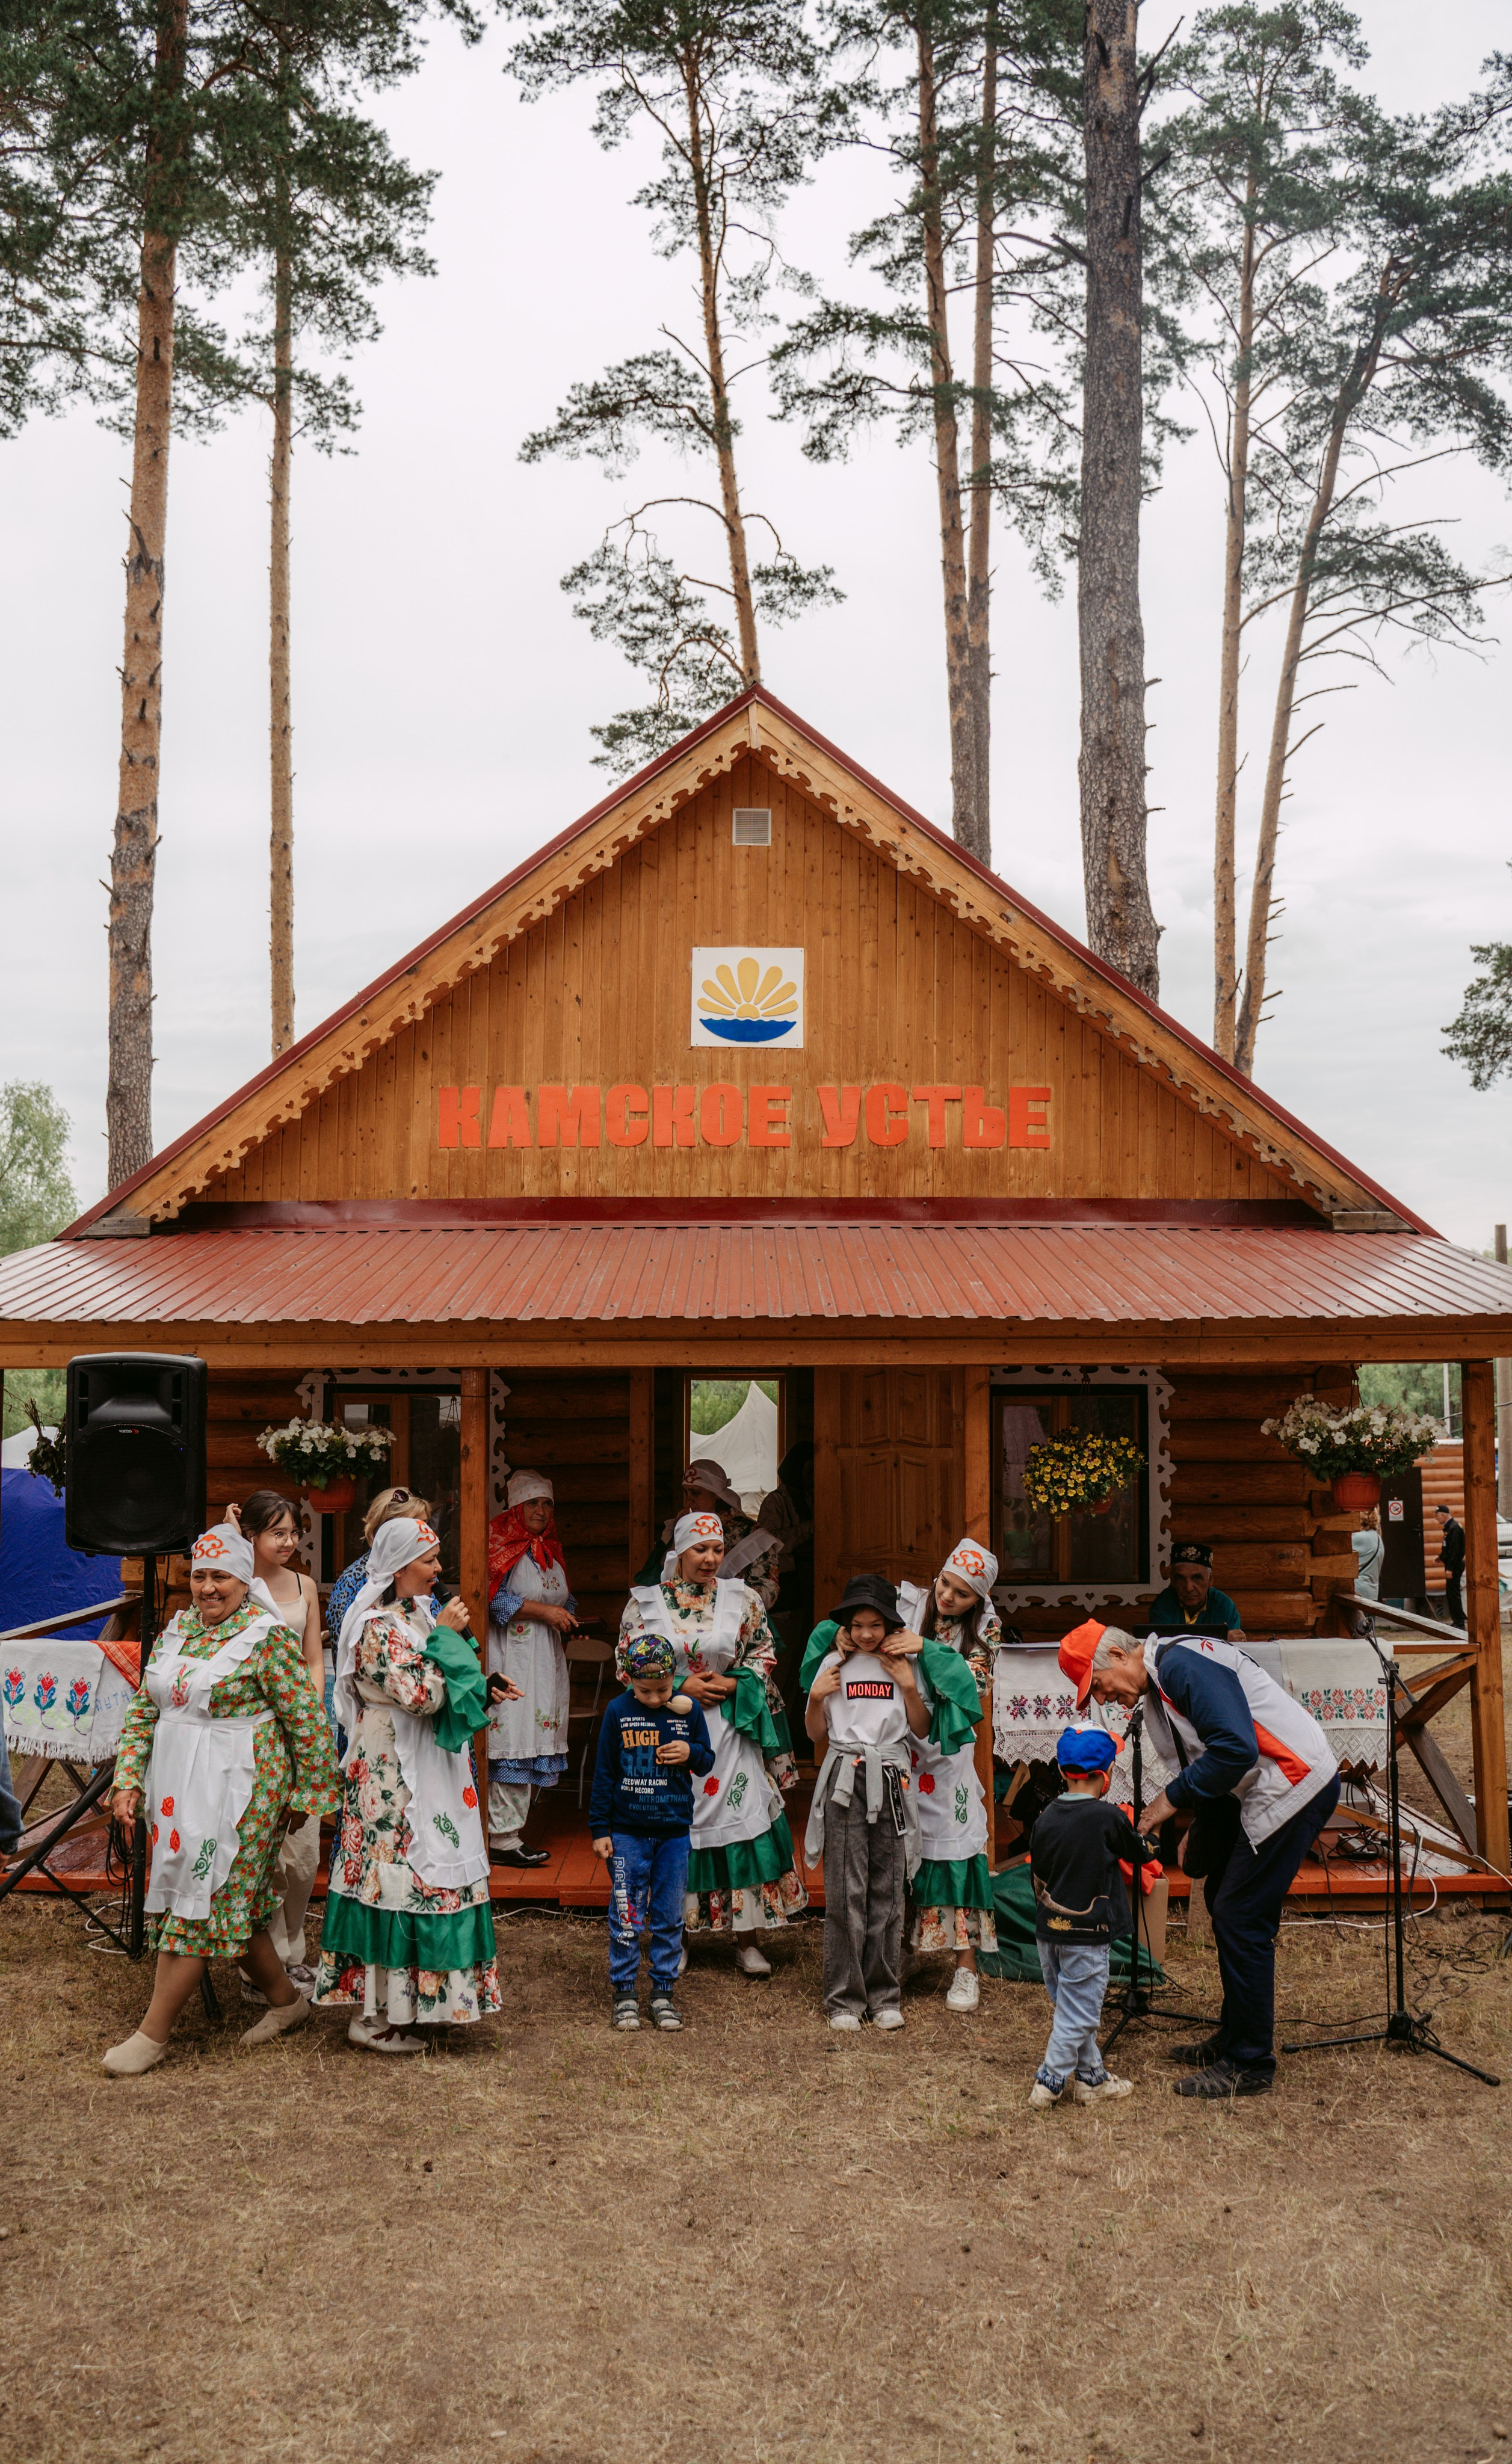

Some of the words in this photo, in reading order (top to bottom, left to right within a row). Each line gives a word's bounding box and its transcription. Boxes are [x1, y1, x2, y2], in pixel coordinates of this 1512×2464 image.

[438, 1083, 791, 1148] КАМСКОЕ
[817, 1083, 1051, 1148] УСТЬЕ
[848, 1684, 891, 1697] MONDAY
[622, 1729, 660, 1748] HIGH
[639, 1794, 690, 1803] NITROMETHANE
